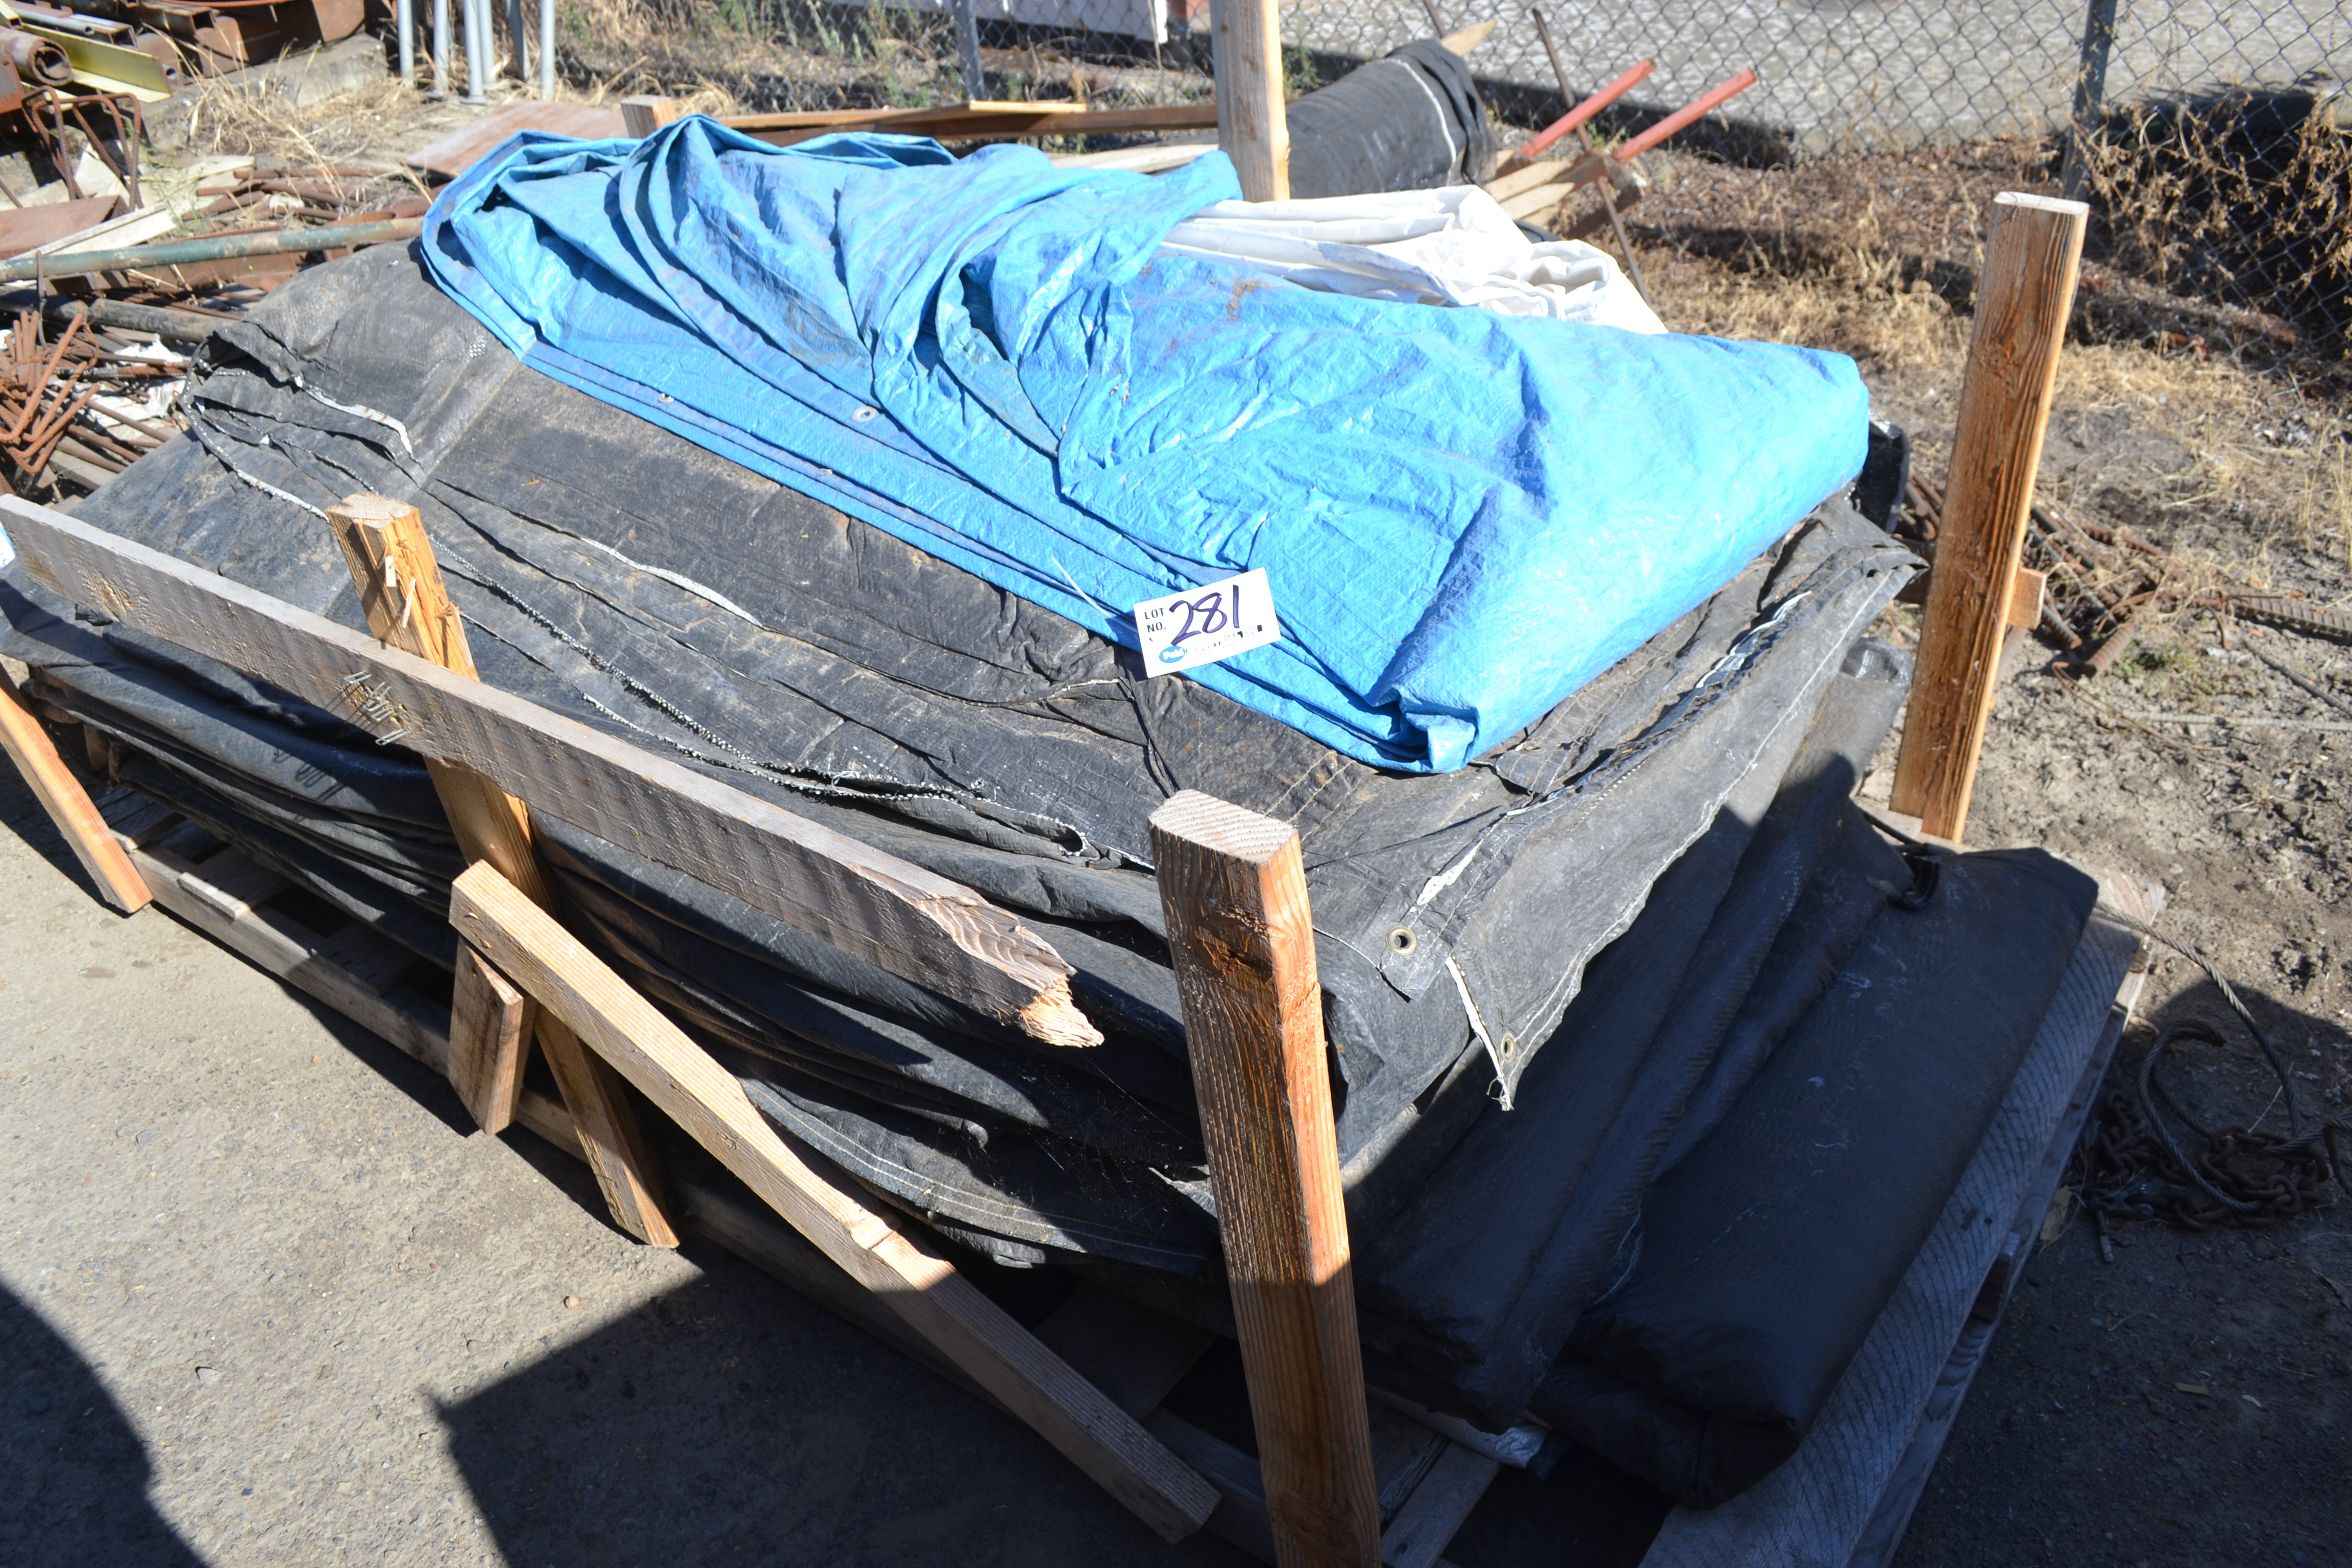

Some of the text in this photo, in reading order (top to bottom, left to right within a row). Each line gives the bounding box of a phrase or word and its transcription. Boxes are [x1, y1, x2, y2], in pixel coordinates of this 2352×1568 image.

[1144, 607, 1165, 620] LOT
[1169, 584, 1240, 646] 281
[1147, 622, 1166, 633] NO.
